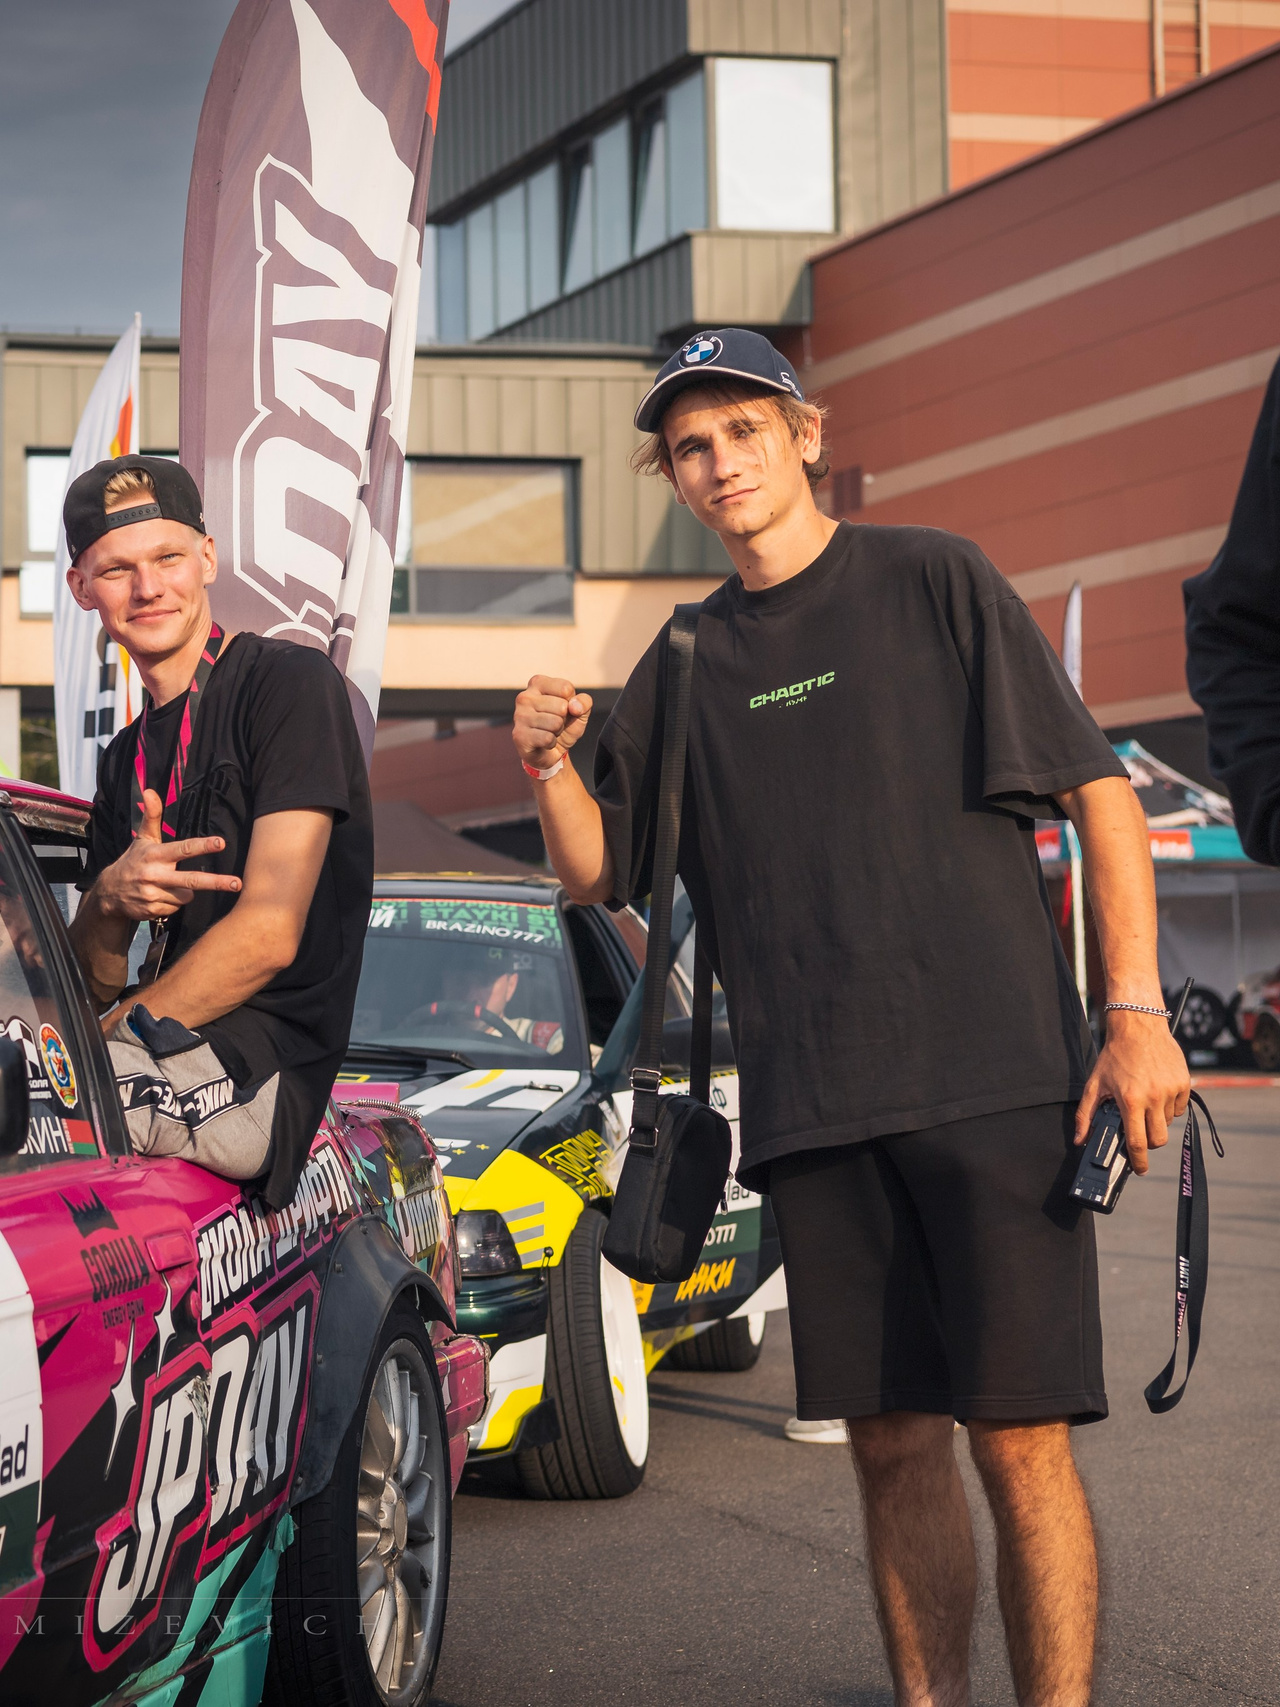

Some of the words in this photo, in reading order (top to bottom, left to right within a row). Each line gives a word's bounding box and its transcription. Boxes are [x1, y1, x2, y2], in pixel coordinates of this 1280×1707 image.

[749, 671, 835, 709] CHAOTIC
[420, 908, 518, 923] STAYKI
[194, 1077, 235, 1120] NIKE
[80, 1235, 151, 1304] GORILLA
[102, 1305, 126, 1329] ENERGY
